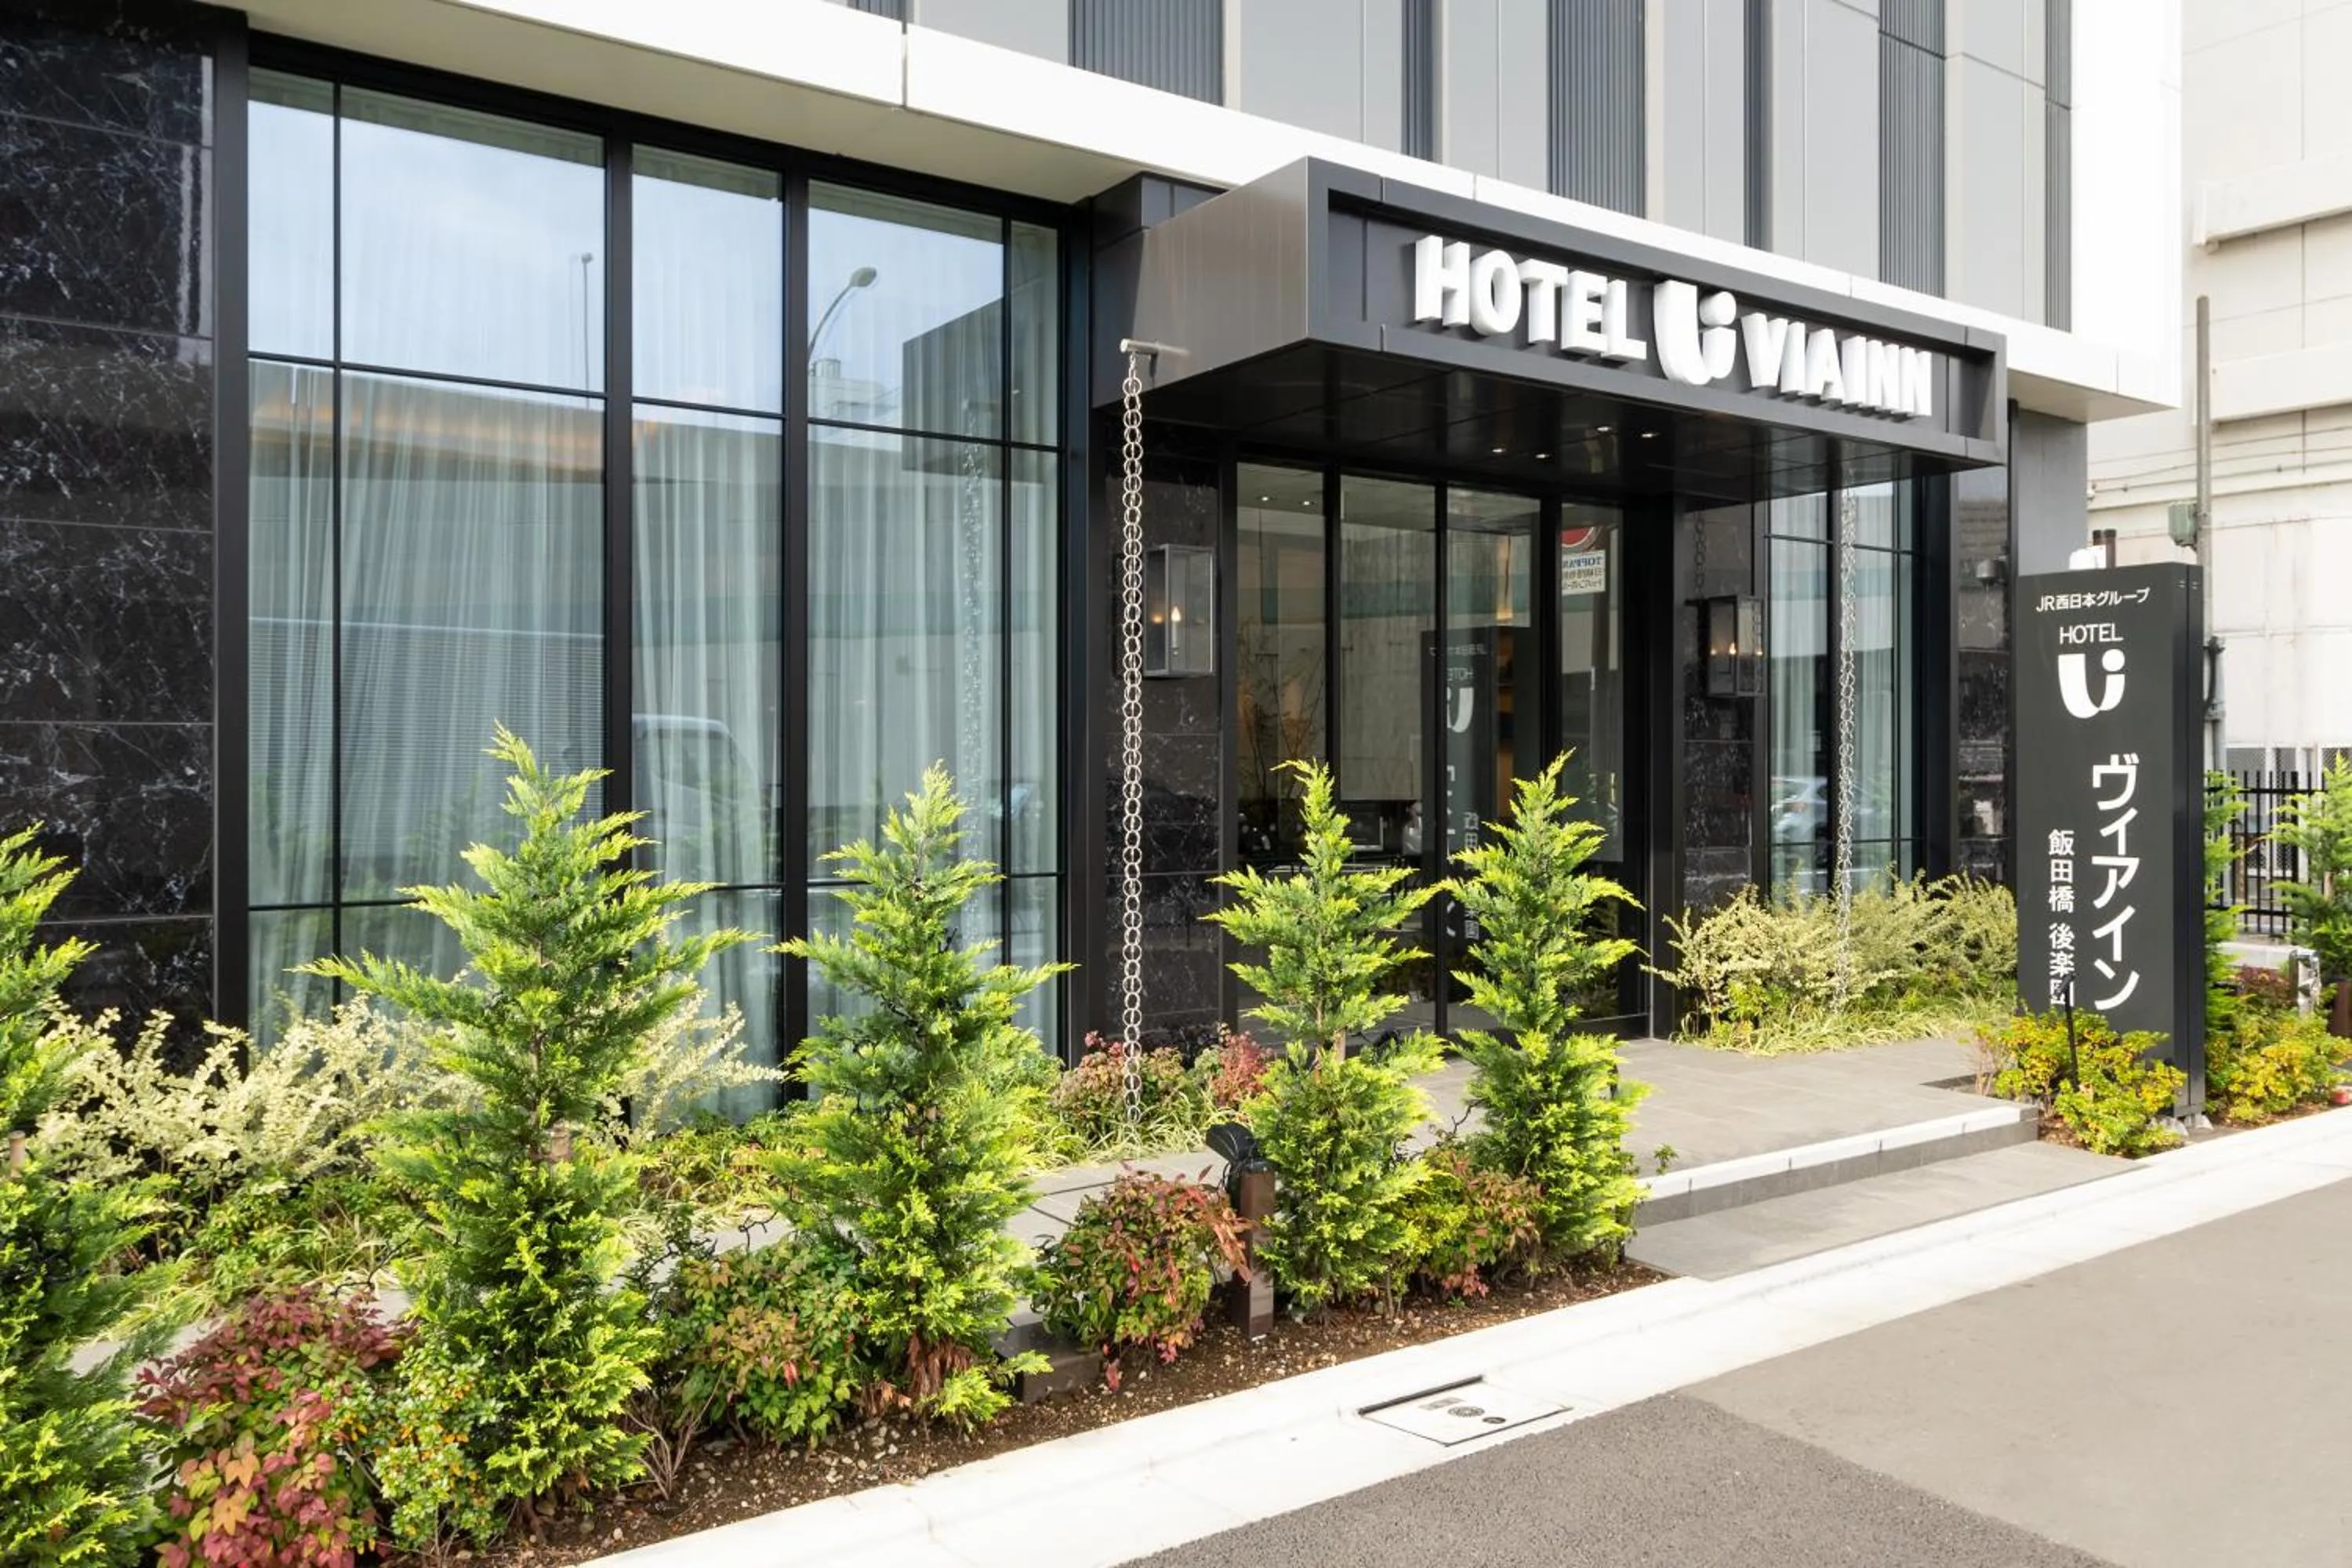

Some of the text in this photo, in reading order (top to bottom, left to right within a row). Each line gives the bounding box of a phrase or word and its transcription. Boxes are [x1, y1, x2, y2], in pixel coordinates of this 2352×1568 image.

[1415, 234, 1647, 360] HOTEL
[2035, 586, 2151, 612] JR西日本グループ
[2059, 622, 2124, 644] HOTEL
[2048, 829, 2075, 913] 飯田橋
[2091, 753, 2140, 1011] ヴィアイン
